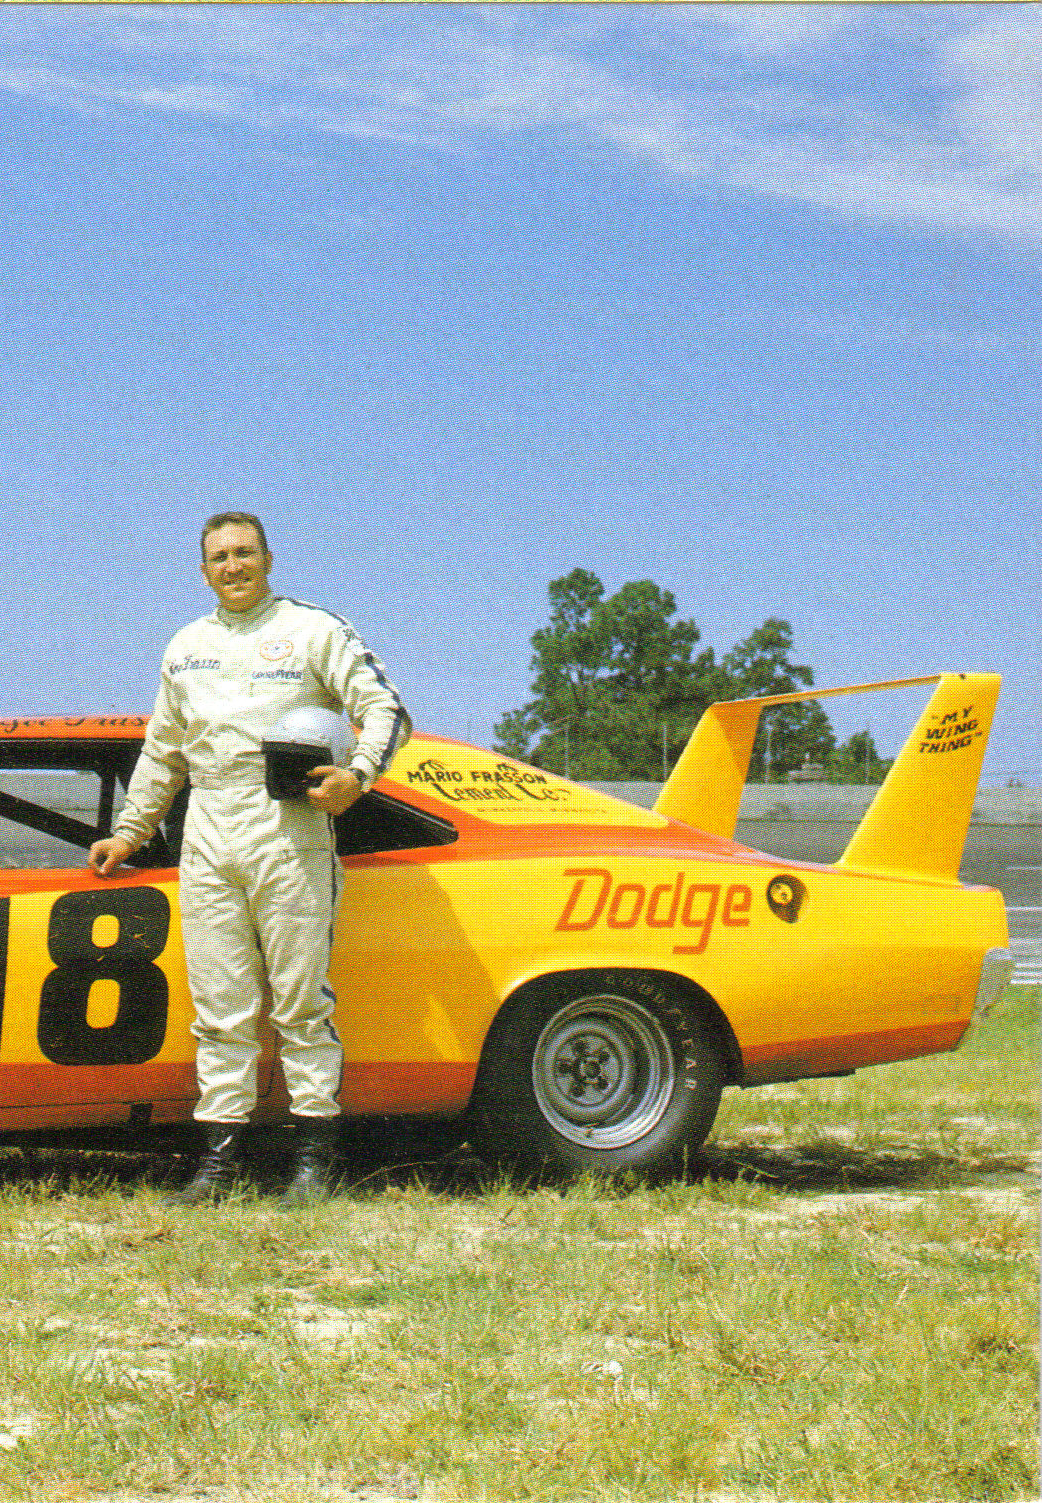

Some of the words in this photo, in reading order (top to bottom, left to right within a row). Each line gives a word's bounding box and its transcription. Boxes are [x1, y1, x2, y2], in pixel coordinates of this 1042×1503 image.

[925, 718, 979, 740] WING
[406, 770, 463, 783] MARIO
[470, 770, 547, 785] FRASSON
[552, 867, 754, 955] Dodge
